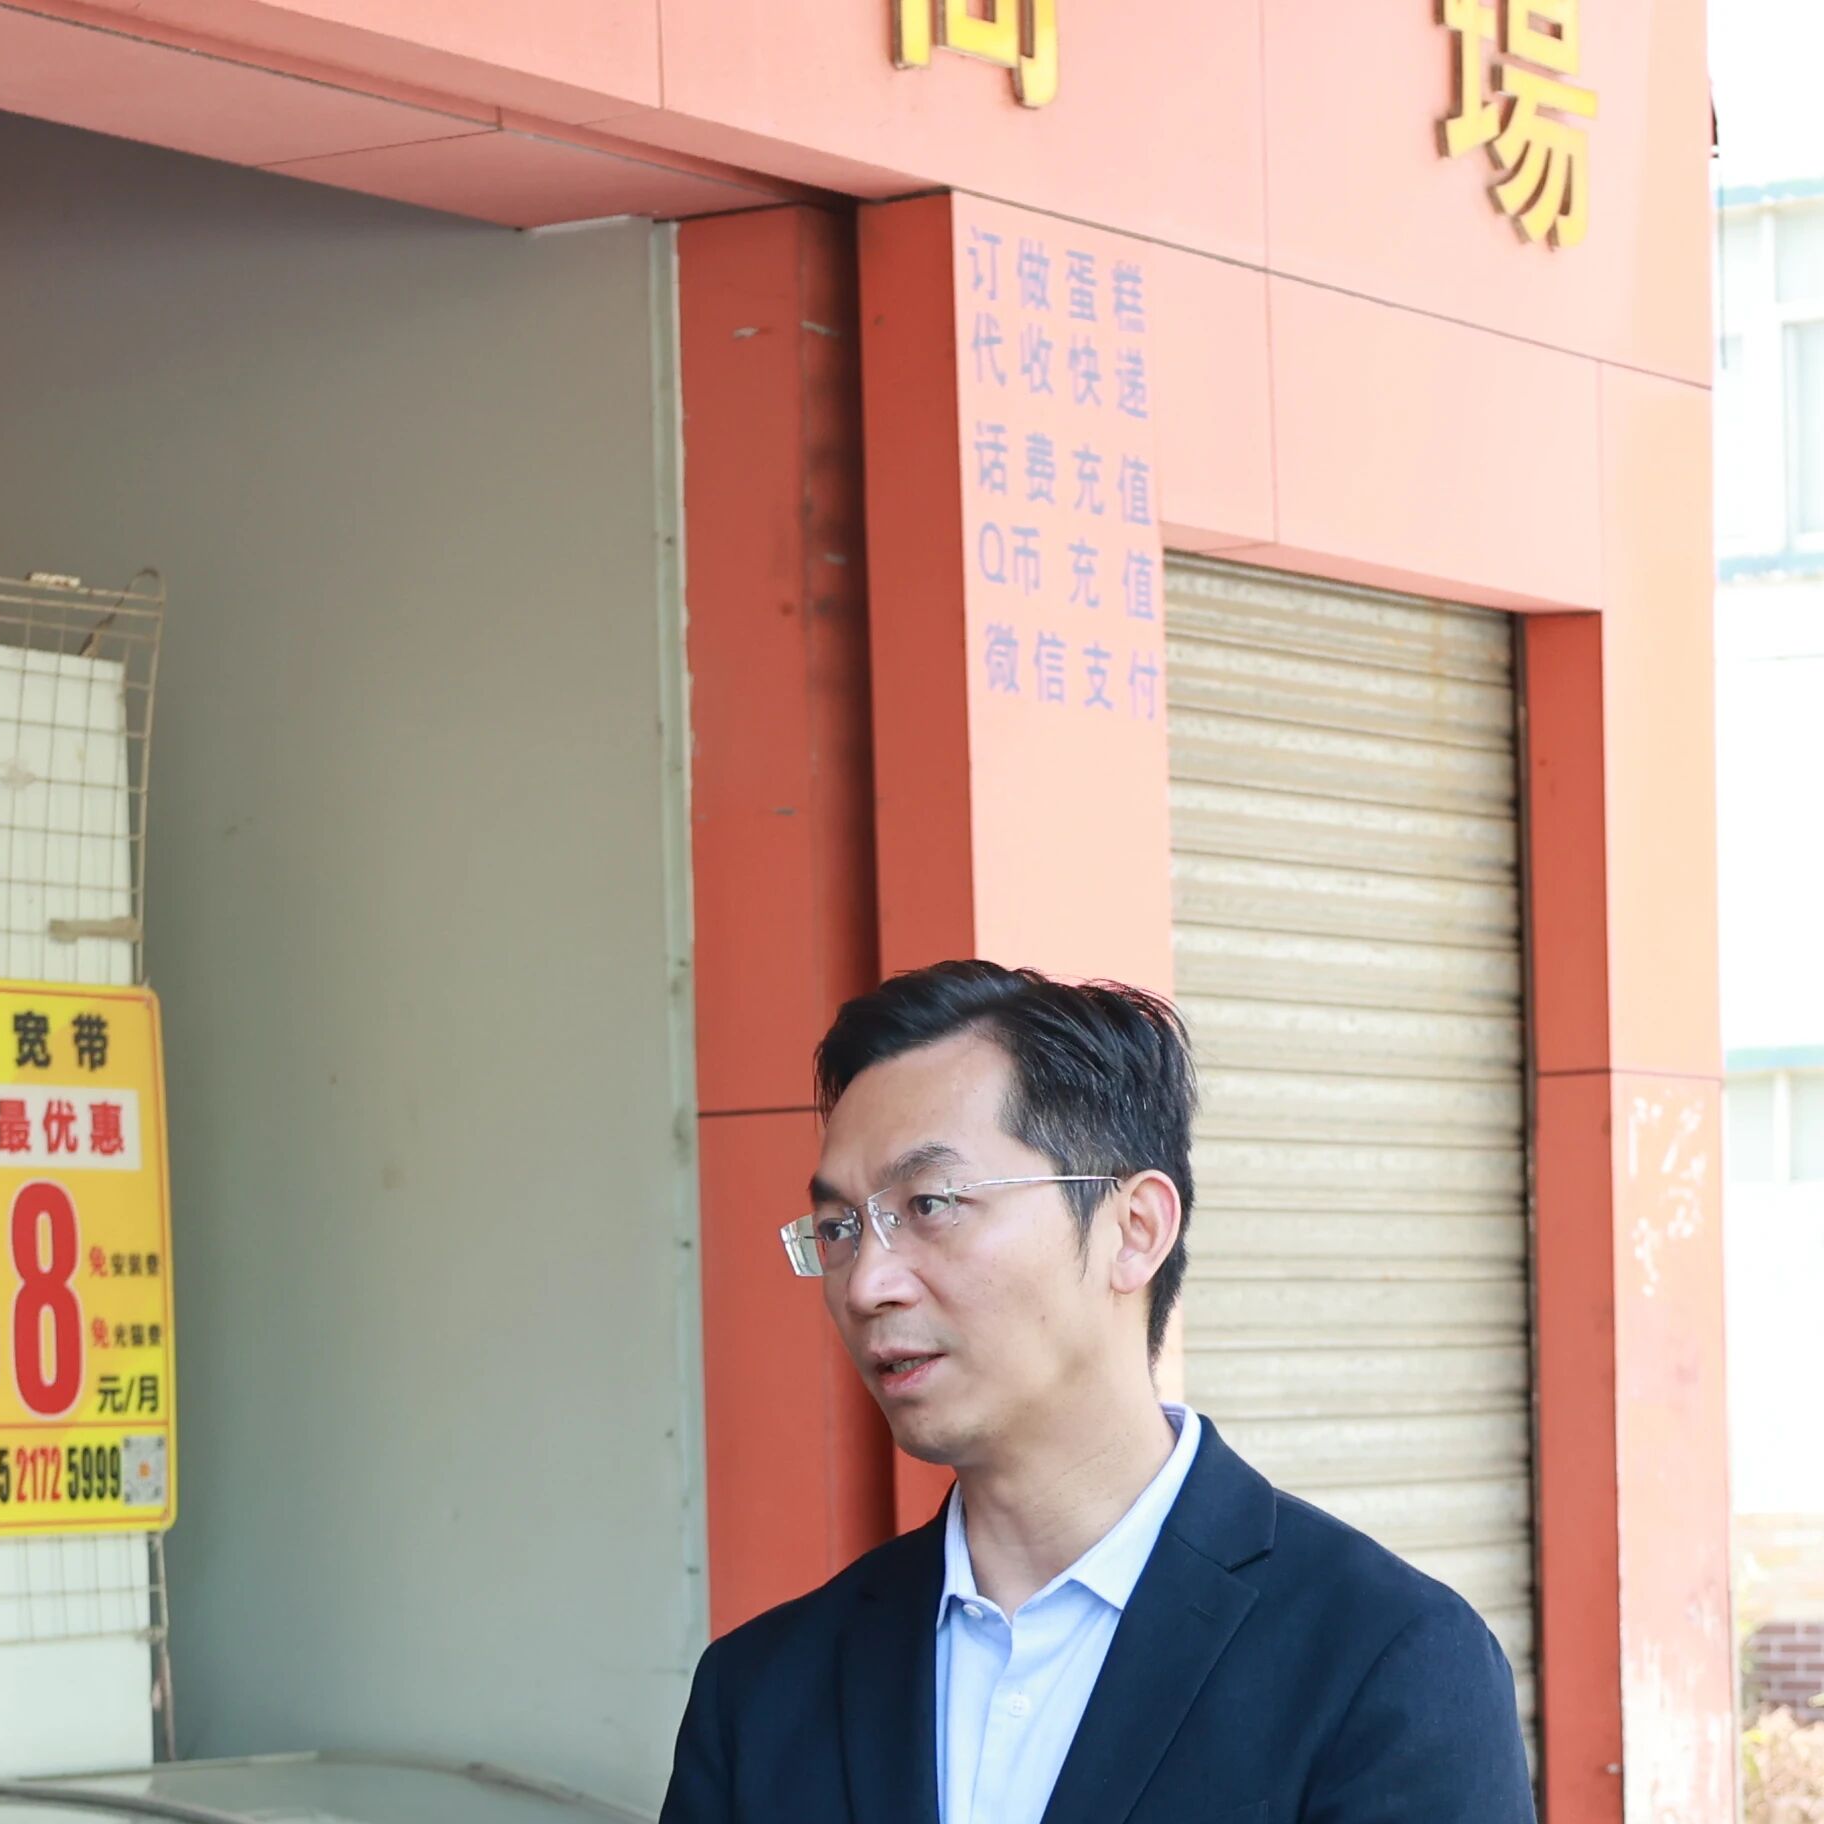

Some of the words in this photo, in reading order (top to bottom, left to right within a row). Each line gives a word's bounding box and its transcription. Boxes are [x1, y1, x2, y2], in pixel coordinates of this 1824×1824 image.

[968, 225, 1145, 333] 订做蛋糕
[972, 312, 1148, 419] 代收快递
[974, 421, 1152, 526] 话费充值
[984, 621, 1159, 721] 微信支付
[97, 1375, 159, 1414] 元/月
